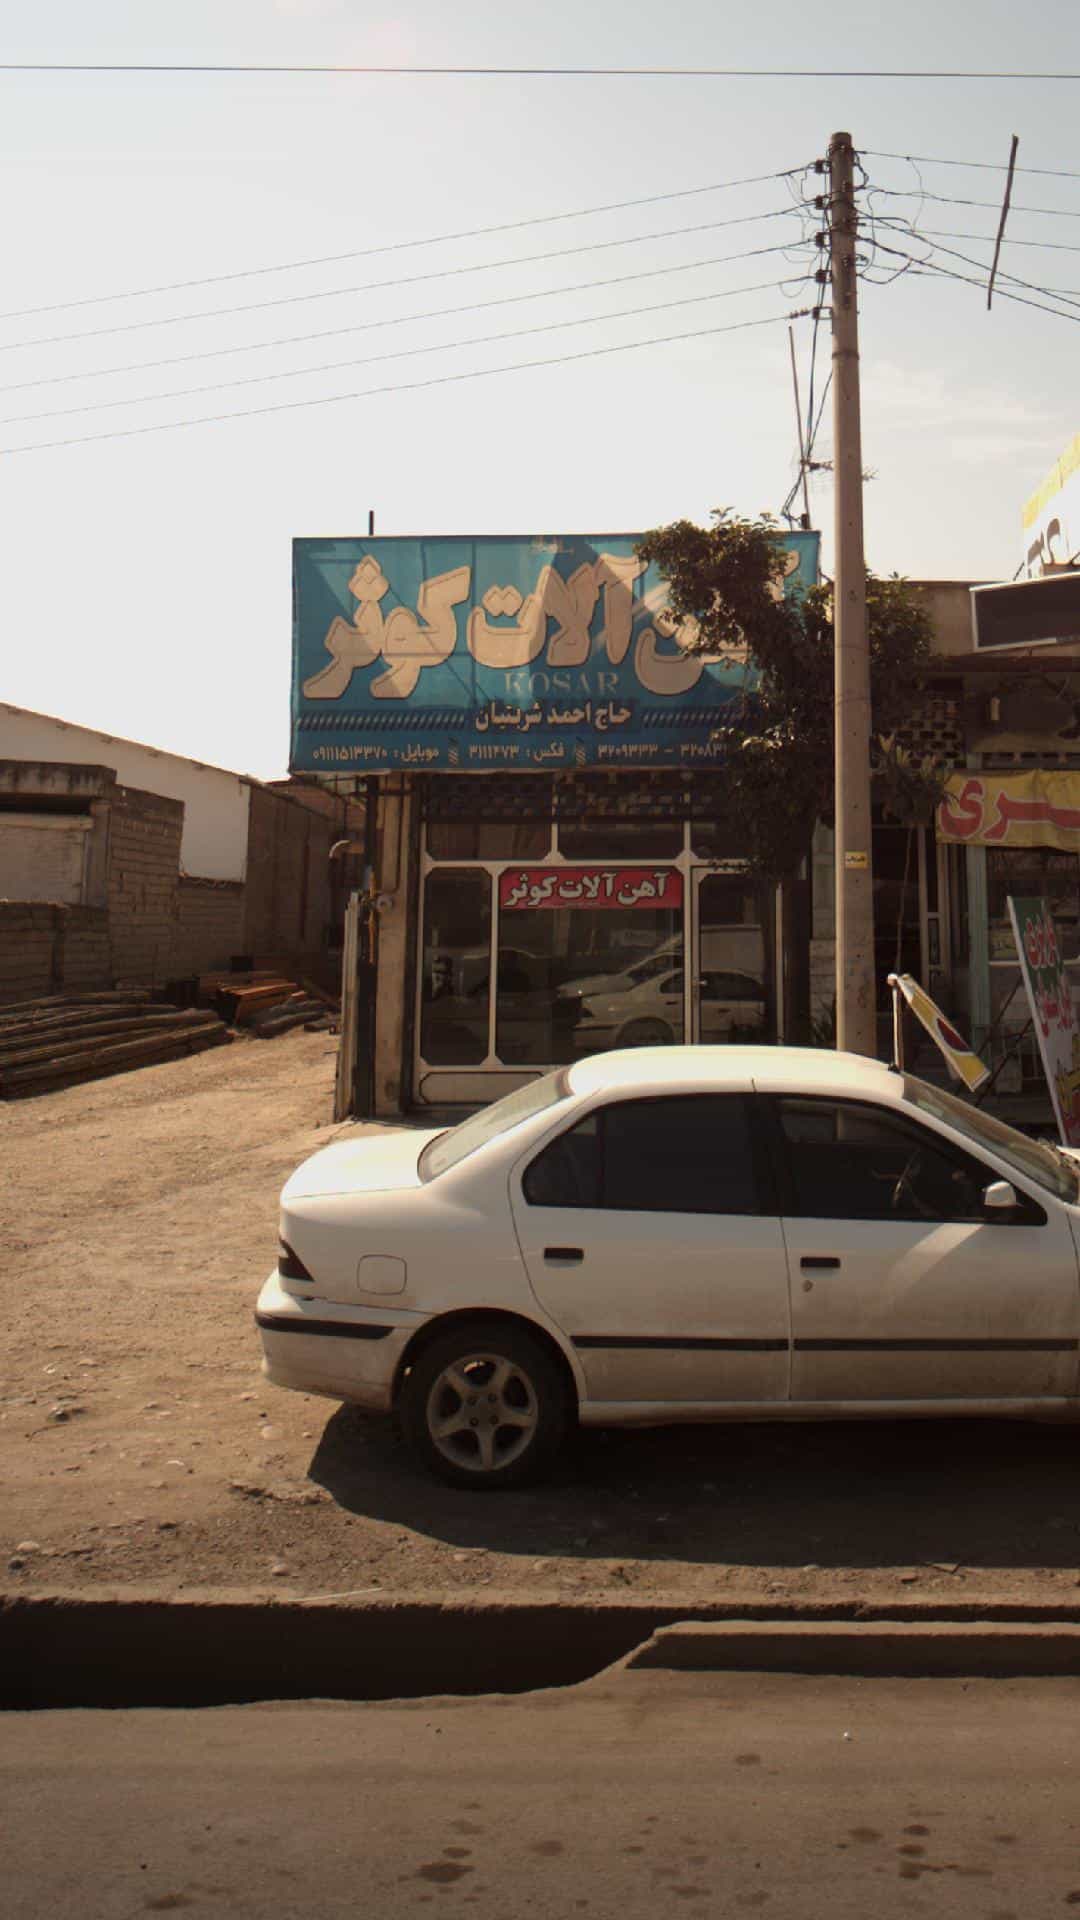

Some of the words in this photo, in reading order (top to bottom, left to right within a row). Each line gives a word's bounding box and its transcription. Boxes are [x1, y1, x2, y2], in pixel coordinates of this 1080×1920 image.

[467, 552, 648, 668] آلات
[303, 553, 471, 699] کوثر
[504, 671, 620, 695] KOSAR
[547, 701, 591, 724] احمد
[595, 701, 631, 730] حاج
[504, 872, 557, 906] کوثر
[559, 872, 617, 899] آلات
[617, 872, 671, 905] آهن
